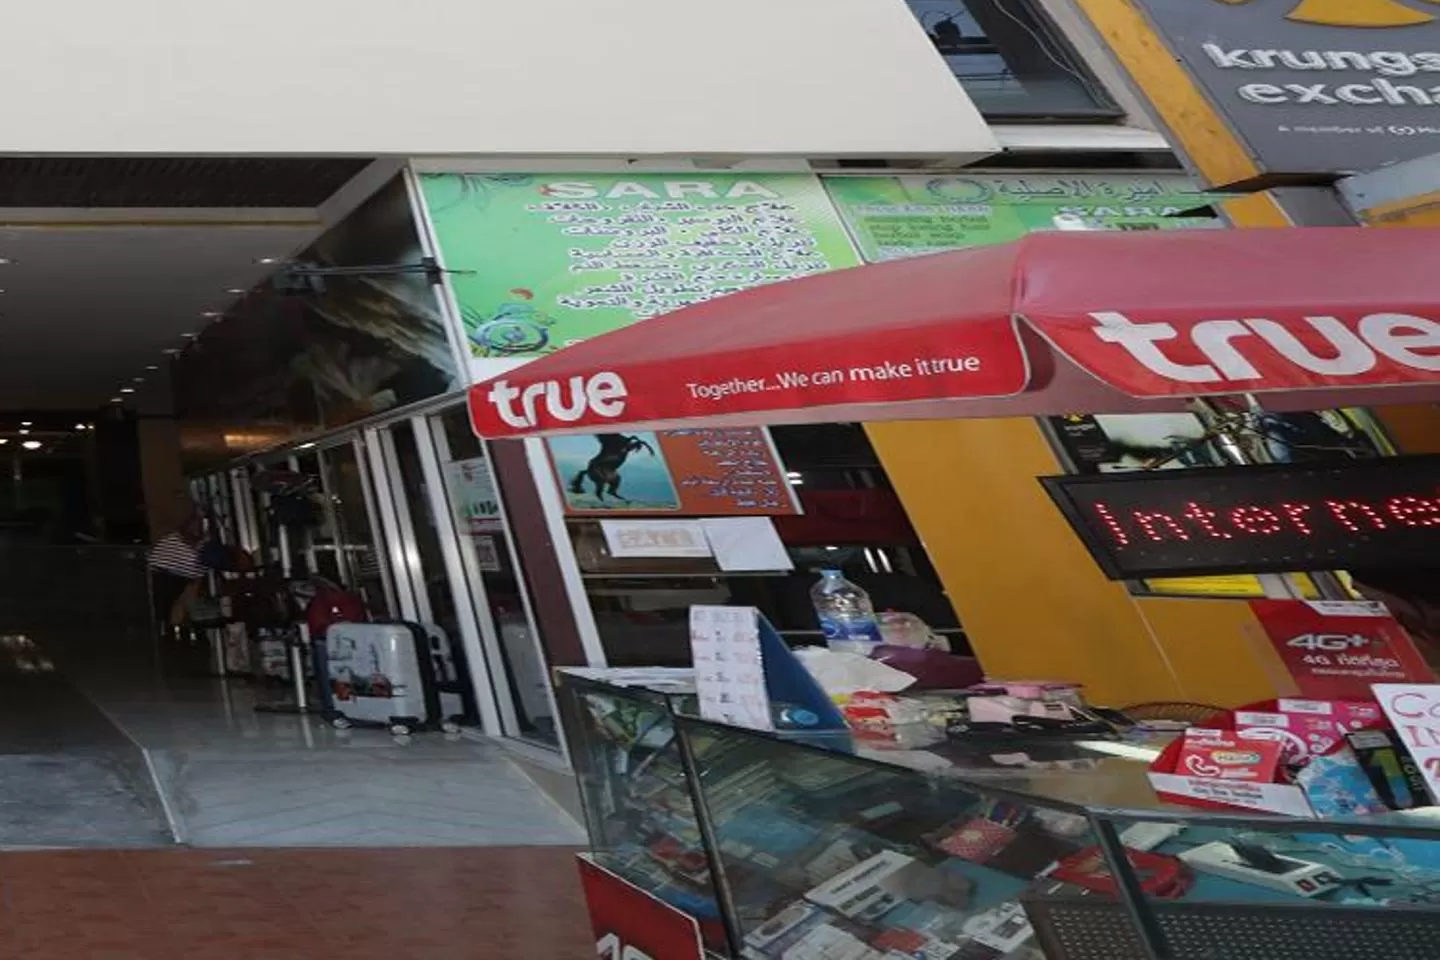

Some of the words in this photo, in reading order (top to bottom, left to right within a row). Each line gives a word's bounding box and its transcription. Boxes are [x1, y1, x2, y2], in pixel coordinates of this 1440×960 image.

[1238, 77, 1440, 105] exch
[544, 181, 780, 199] SARA
[1087, 310, 1440, 382] true
[812, 368, 843, 386] can
[850, 360, 911, 382] make
[488, 371, 628, 429] true
